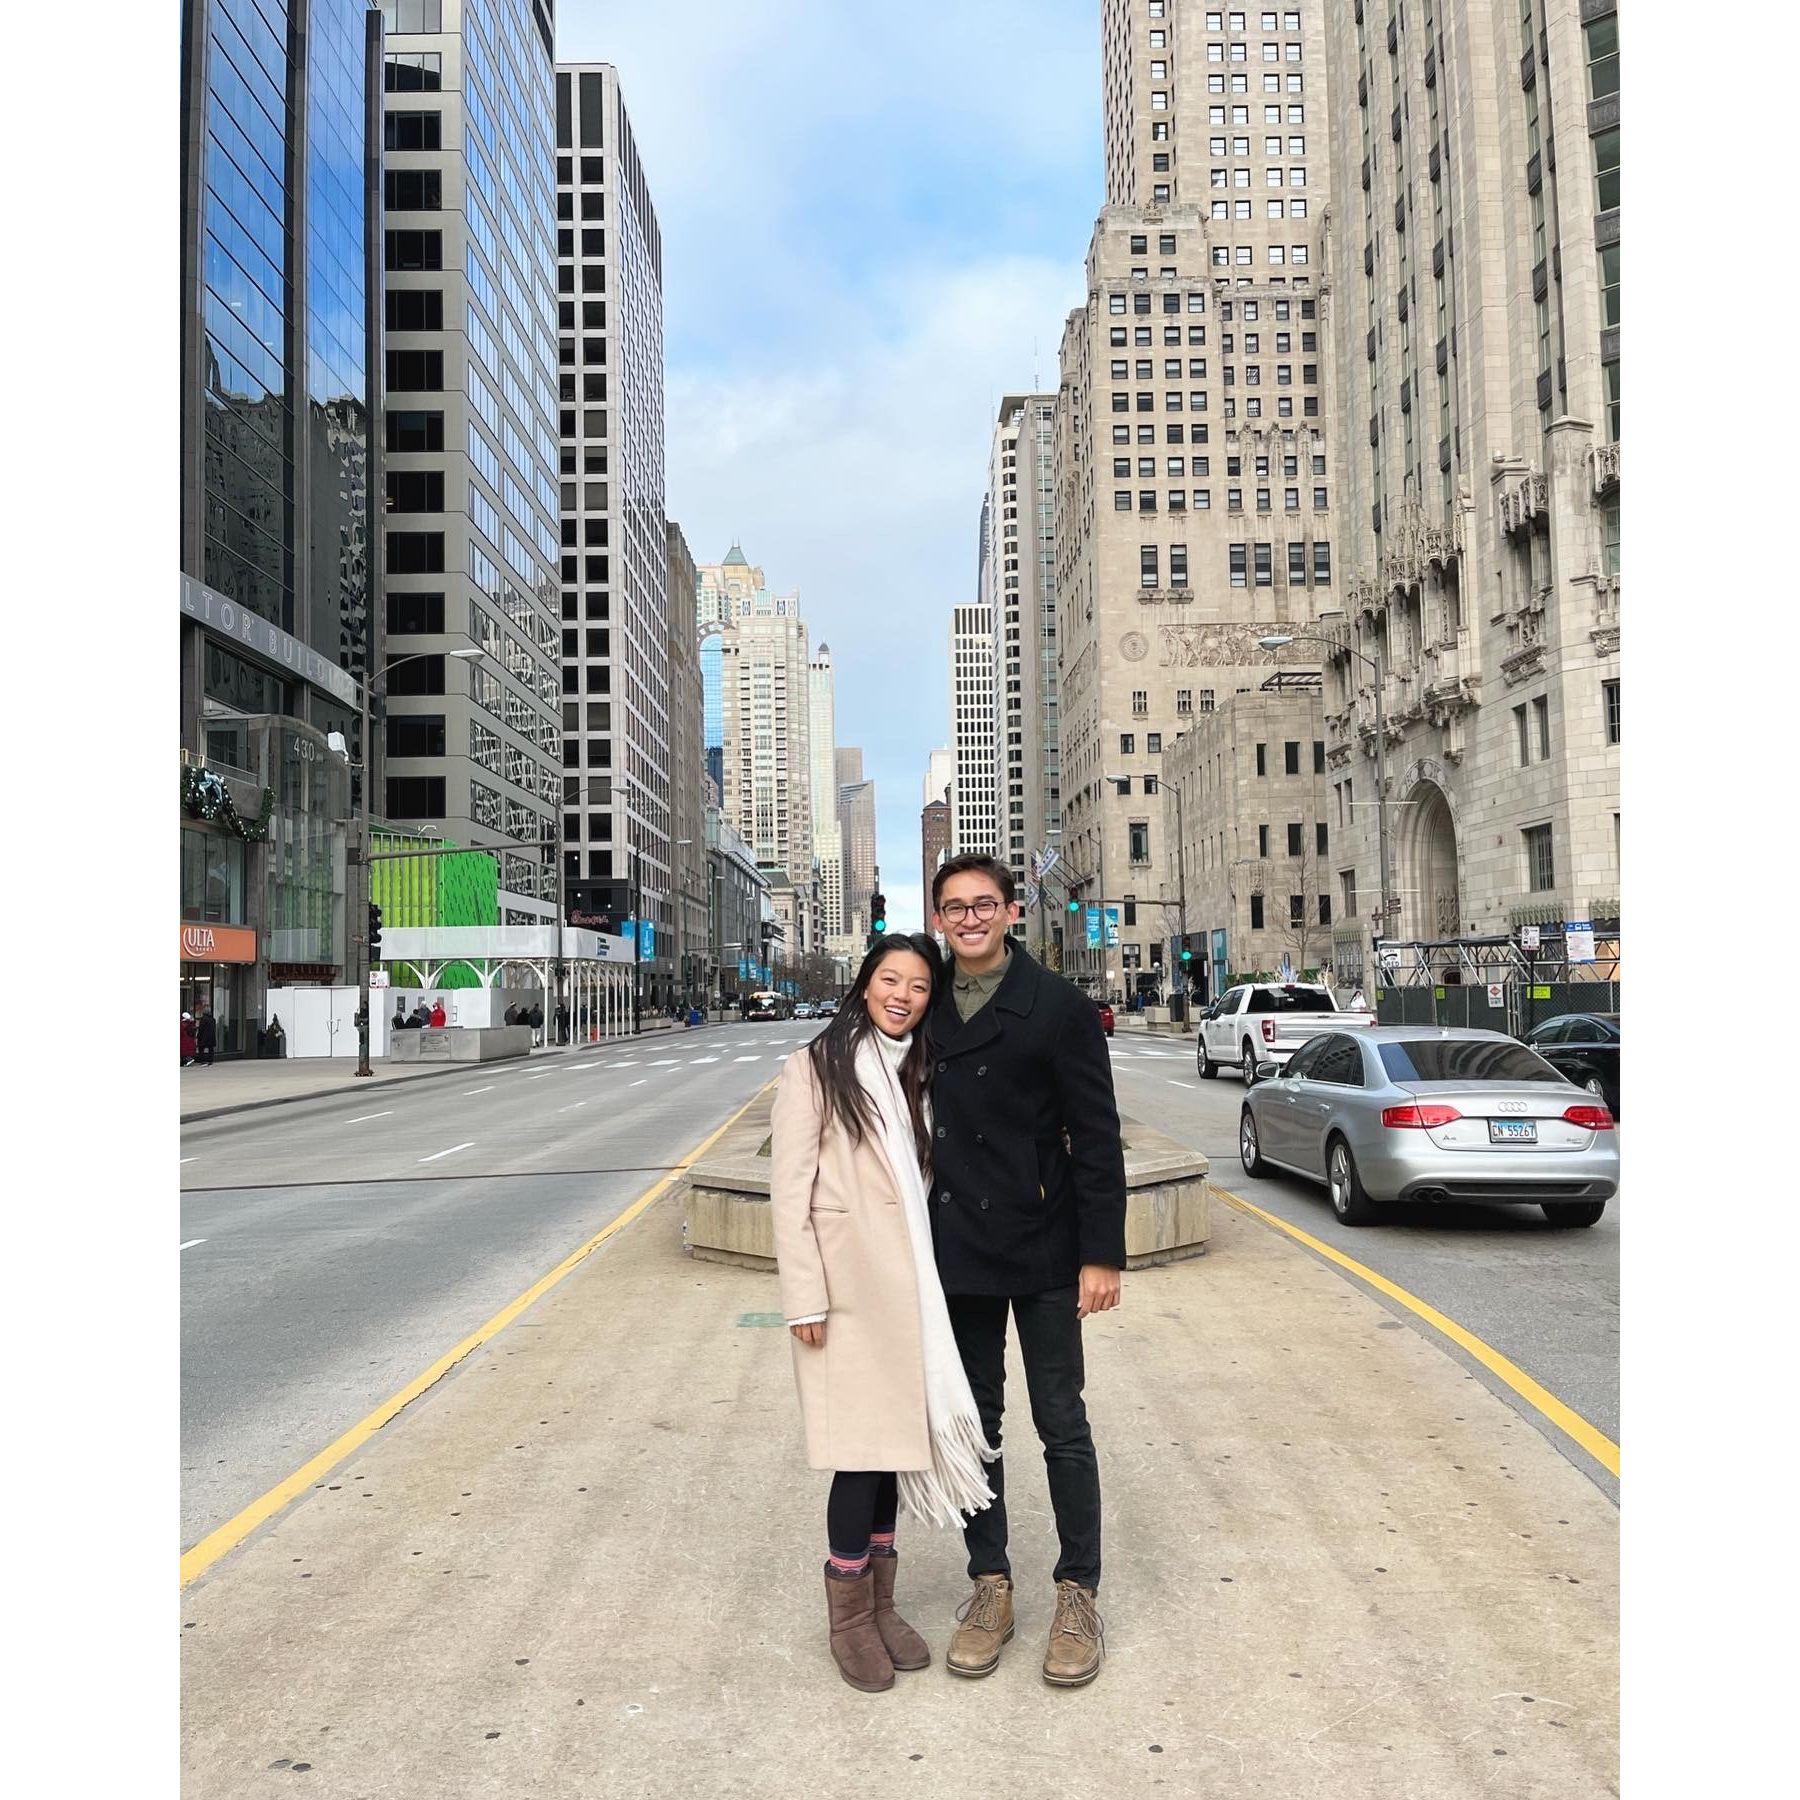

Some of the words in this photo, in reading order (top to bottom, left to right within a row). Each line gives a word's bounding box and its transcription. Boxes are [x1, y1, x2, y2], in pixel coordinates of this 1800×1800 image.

[293, 736, 315, 761] 430
[188, 927, 215, 947] ULTA
[1507, 1124, 1535, 1137] 55267
